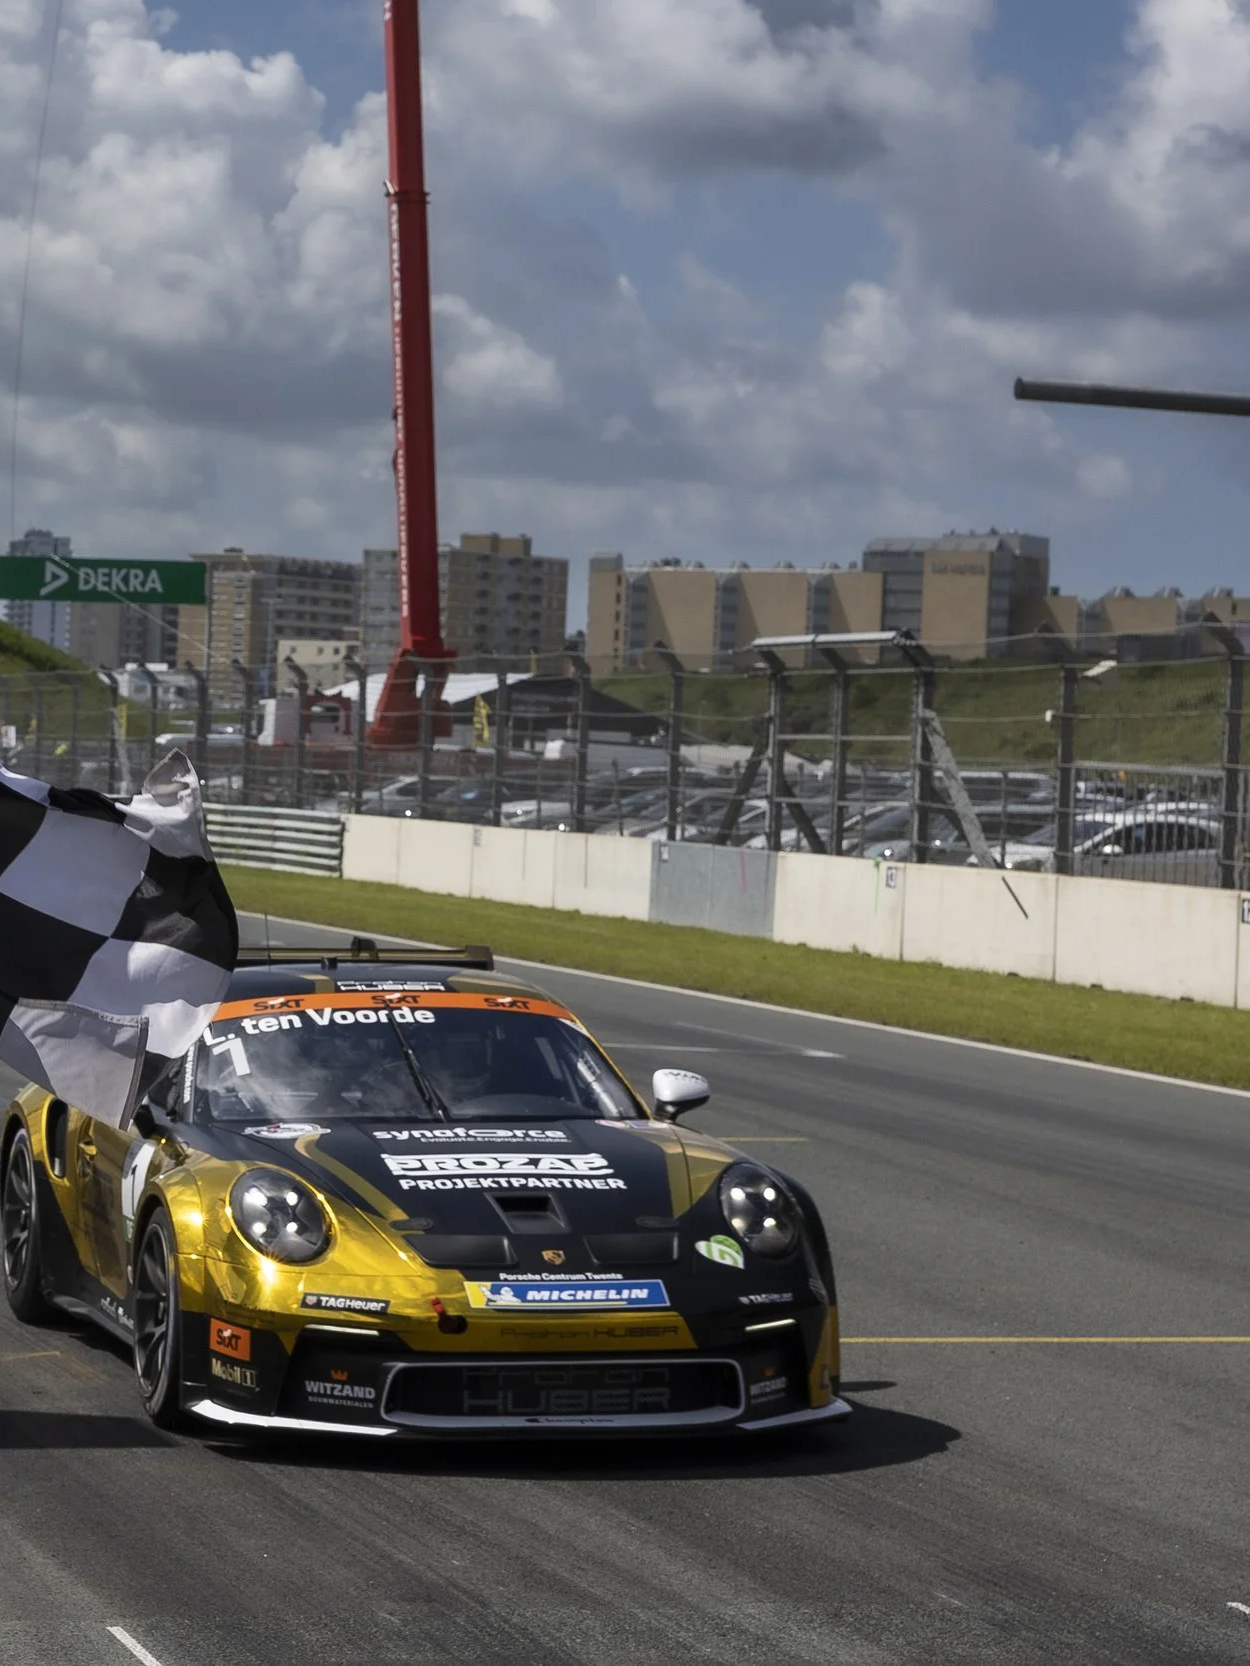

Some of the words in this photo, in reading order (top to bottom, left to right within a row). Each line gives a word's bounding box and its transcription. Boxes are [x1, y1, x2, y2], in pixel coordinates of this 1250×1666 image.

[78, 567, 163, 593] DEKRA
[203, 1024, 236, 1046] L.
[240, 1010, 303, 1035] ten
[304, 1006, 436, 1027] Voorde
[212, 1037, 250, 1076] 1
[372, 1127, 568, 1140] synaforce
[381, 1153, 614, 1175] PROZAP
[399, 1178, 628, 1190] PROJEKTPARTNER
[499, 1272, 540, 1281] Porsche
[541, 1272, 584, 1281] Centrum
[585, 1272, 624, 1280] Twente
[525, 1288, 649, 1301] MICHELIN
[594, 1325, 679, 1338] HUBER
[212, 1357, 241, 1384] Mobil
[304, 1380, 376, 1399] WITZAND
[462, 1387, 670, 1414] HUBER
